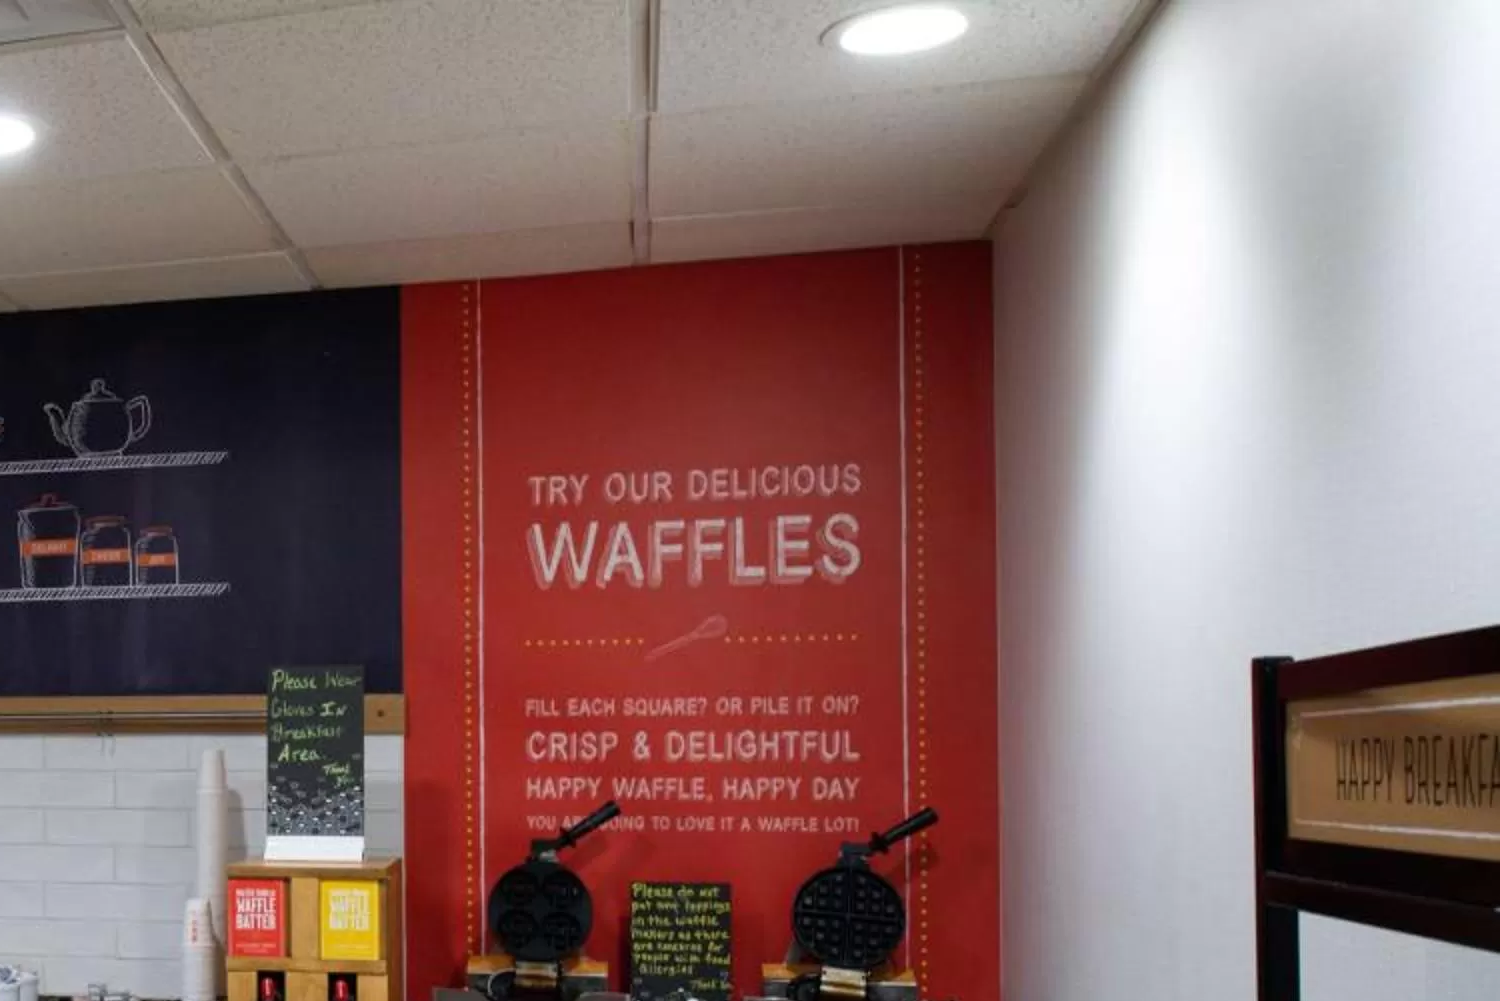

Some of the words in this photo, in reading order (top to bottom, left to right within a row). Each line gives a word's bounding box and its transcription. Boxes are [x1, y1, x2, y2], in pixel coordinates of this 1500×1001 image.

[528, 474, 589, 505] TRY
[604, 472, 672, 501] OUR
[686, 463, 863, 499] DELICIOUS
[527, 513, 863, 590] WAFFLES
[272, 669, 317, 691] Please
[526, 699, 560, 717] FILL
[568, 698, 615, 716] EACH
[623, 697, 707, 717] SQUARE?
[716, 697, 742, 715] OR
[750, 697, 789, 715] PILE
[798, 697, 813, 715] IT
[822, 695, 859, 716] ON?
[526, 732, 618, 762] CRISP
[632, 731, 651, 760] &
[664, 729, 860, 762] DELIGHTFUL
[1336, 735, 1396, 802] HAPPY
[526, 777, 602, 800] HAPPY
[722, 776, 802, 800] HAPPY
[812, 776, 860, 799] DAY
[527, 815, 557, 832] YOU
[652, 814, 670, 832] TO
[677, 814, 714, 832] LOVE
[721, 814, 733, 832] IT
[740, 814, 751, 832] A
[759, 814, 817, 832] WAFFLE
[235, 898, 276, 912] WAFFLE
[235, 913, 276, 929] BATTER
